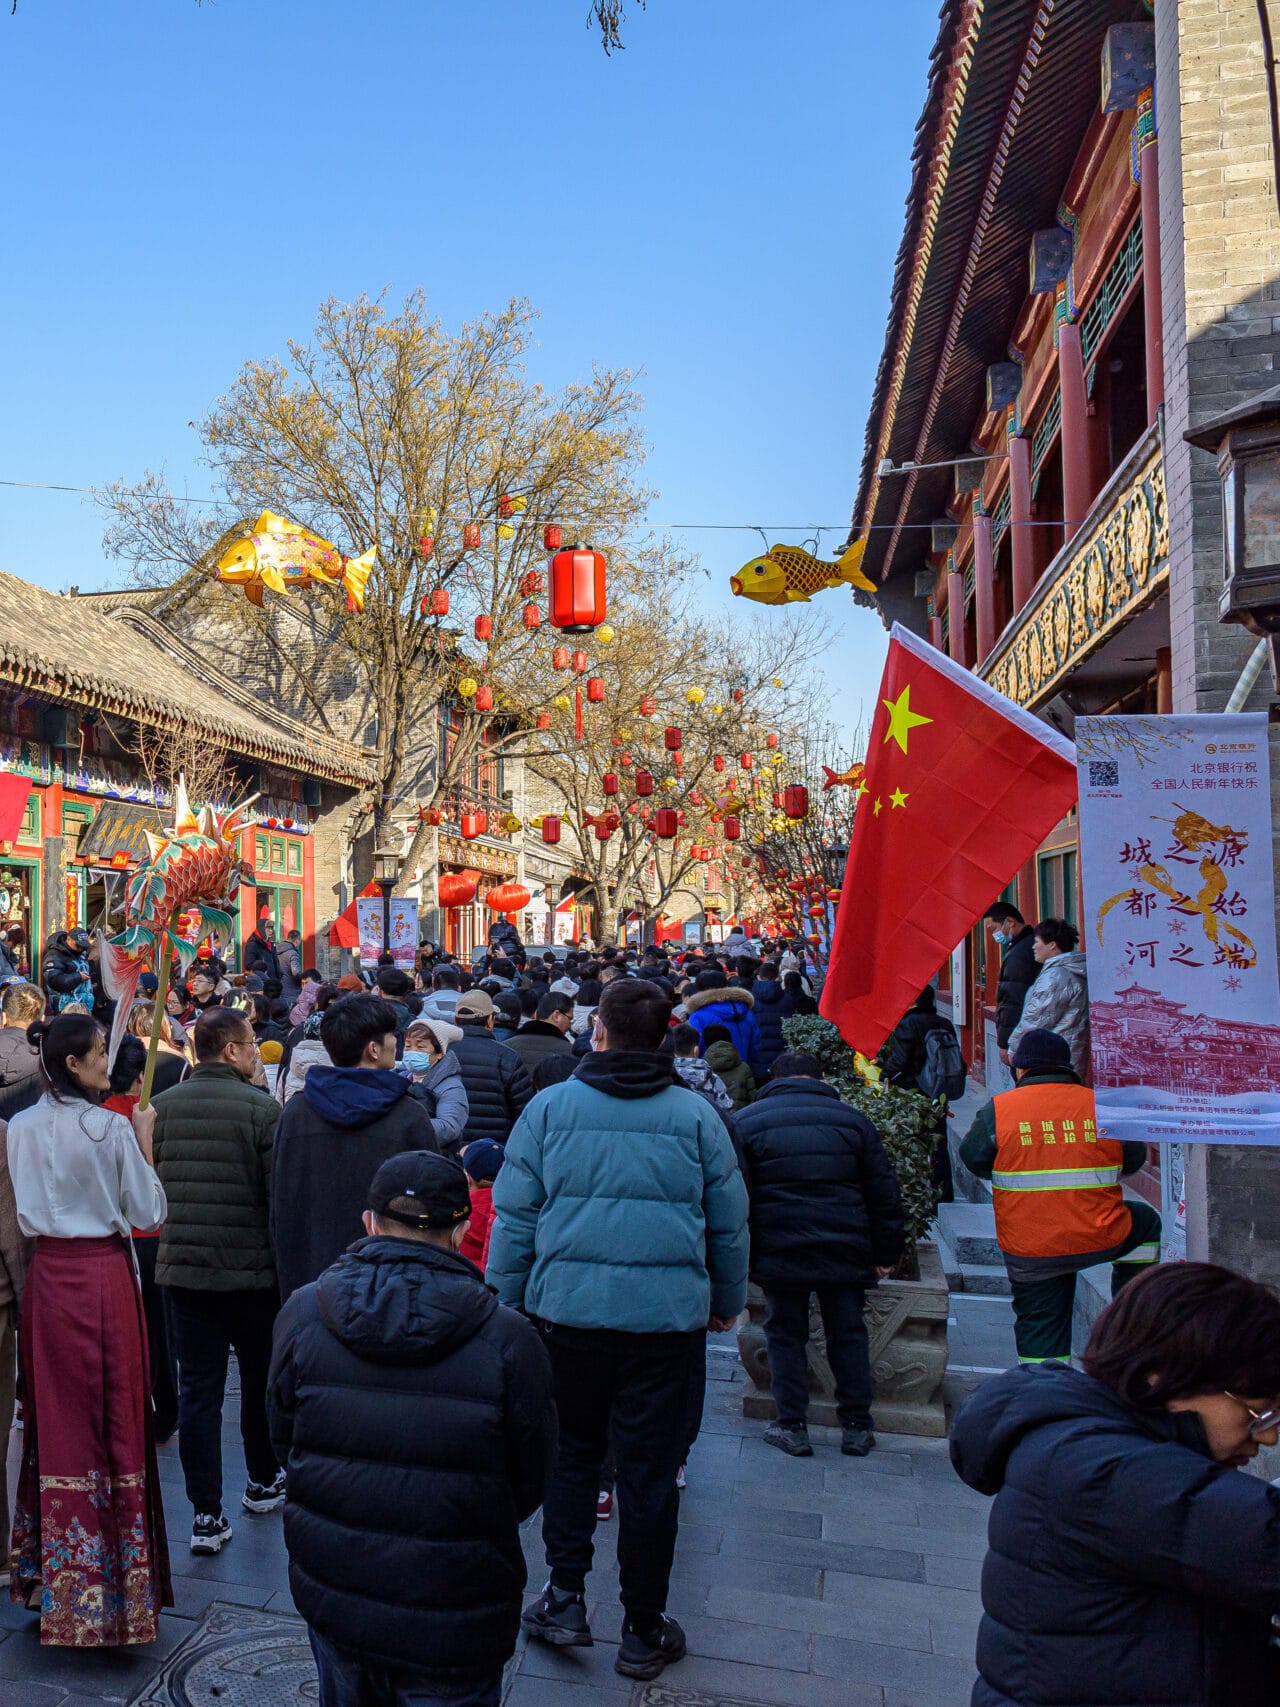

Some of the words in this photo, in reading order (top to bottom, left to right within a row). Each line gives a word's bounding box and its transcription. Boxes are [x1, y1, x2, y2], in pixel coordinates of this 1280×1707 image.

[1190, 761, 1258, 774] 北京银行祝
[1151, 777, 1258, 790] 全国人民新年快乐
[1119, 836, 1245, 868] 城之源
[1124, 888, 1248, 920] 都之始
[1124, 940, 1250, 970] 河之端
